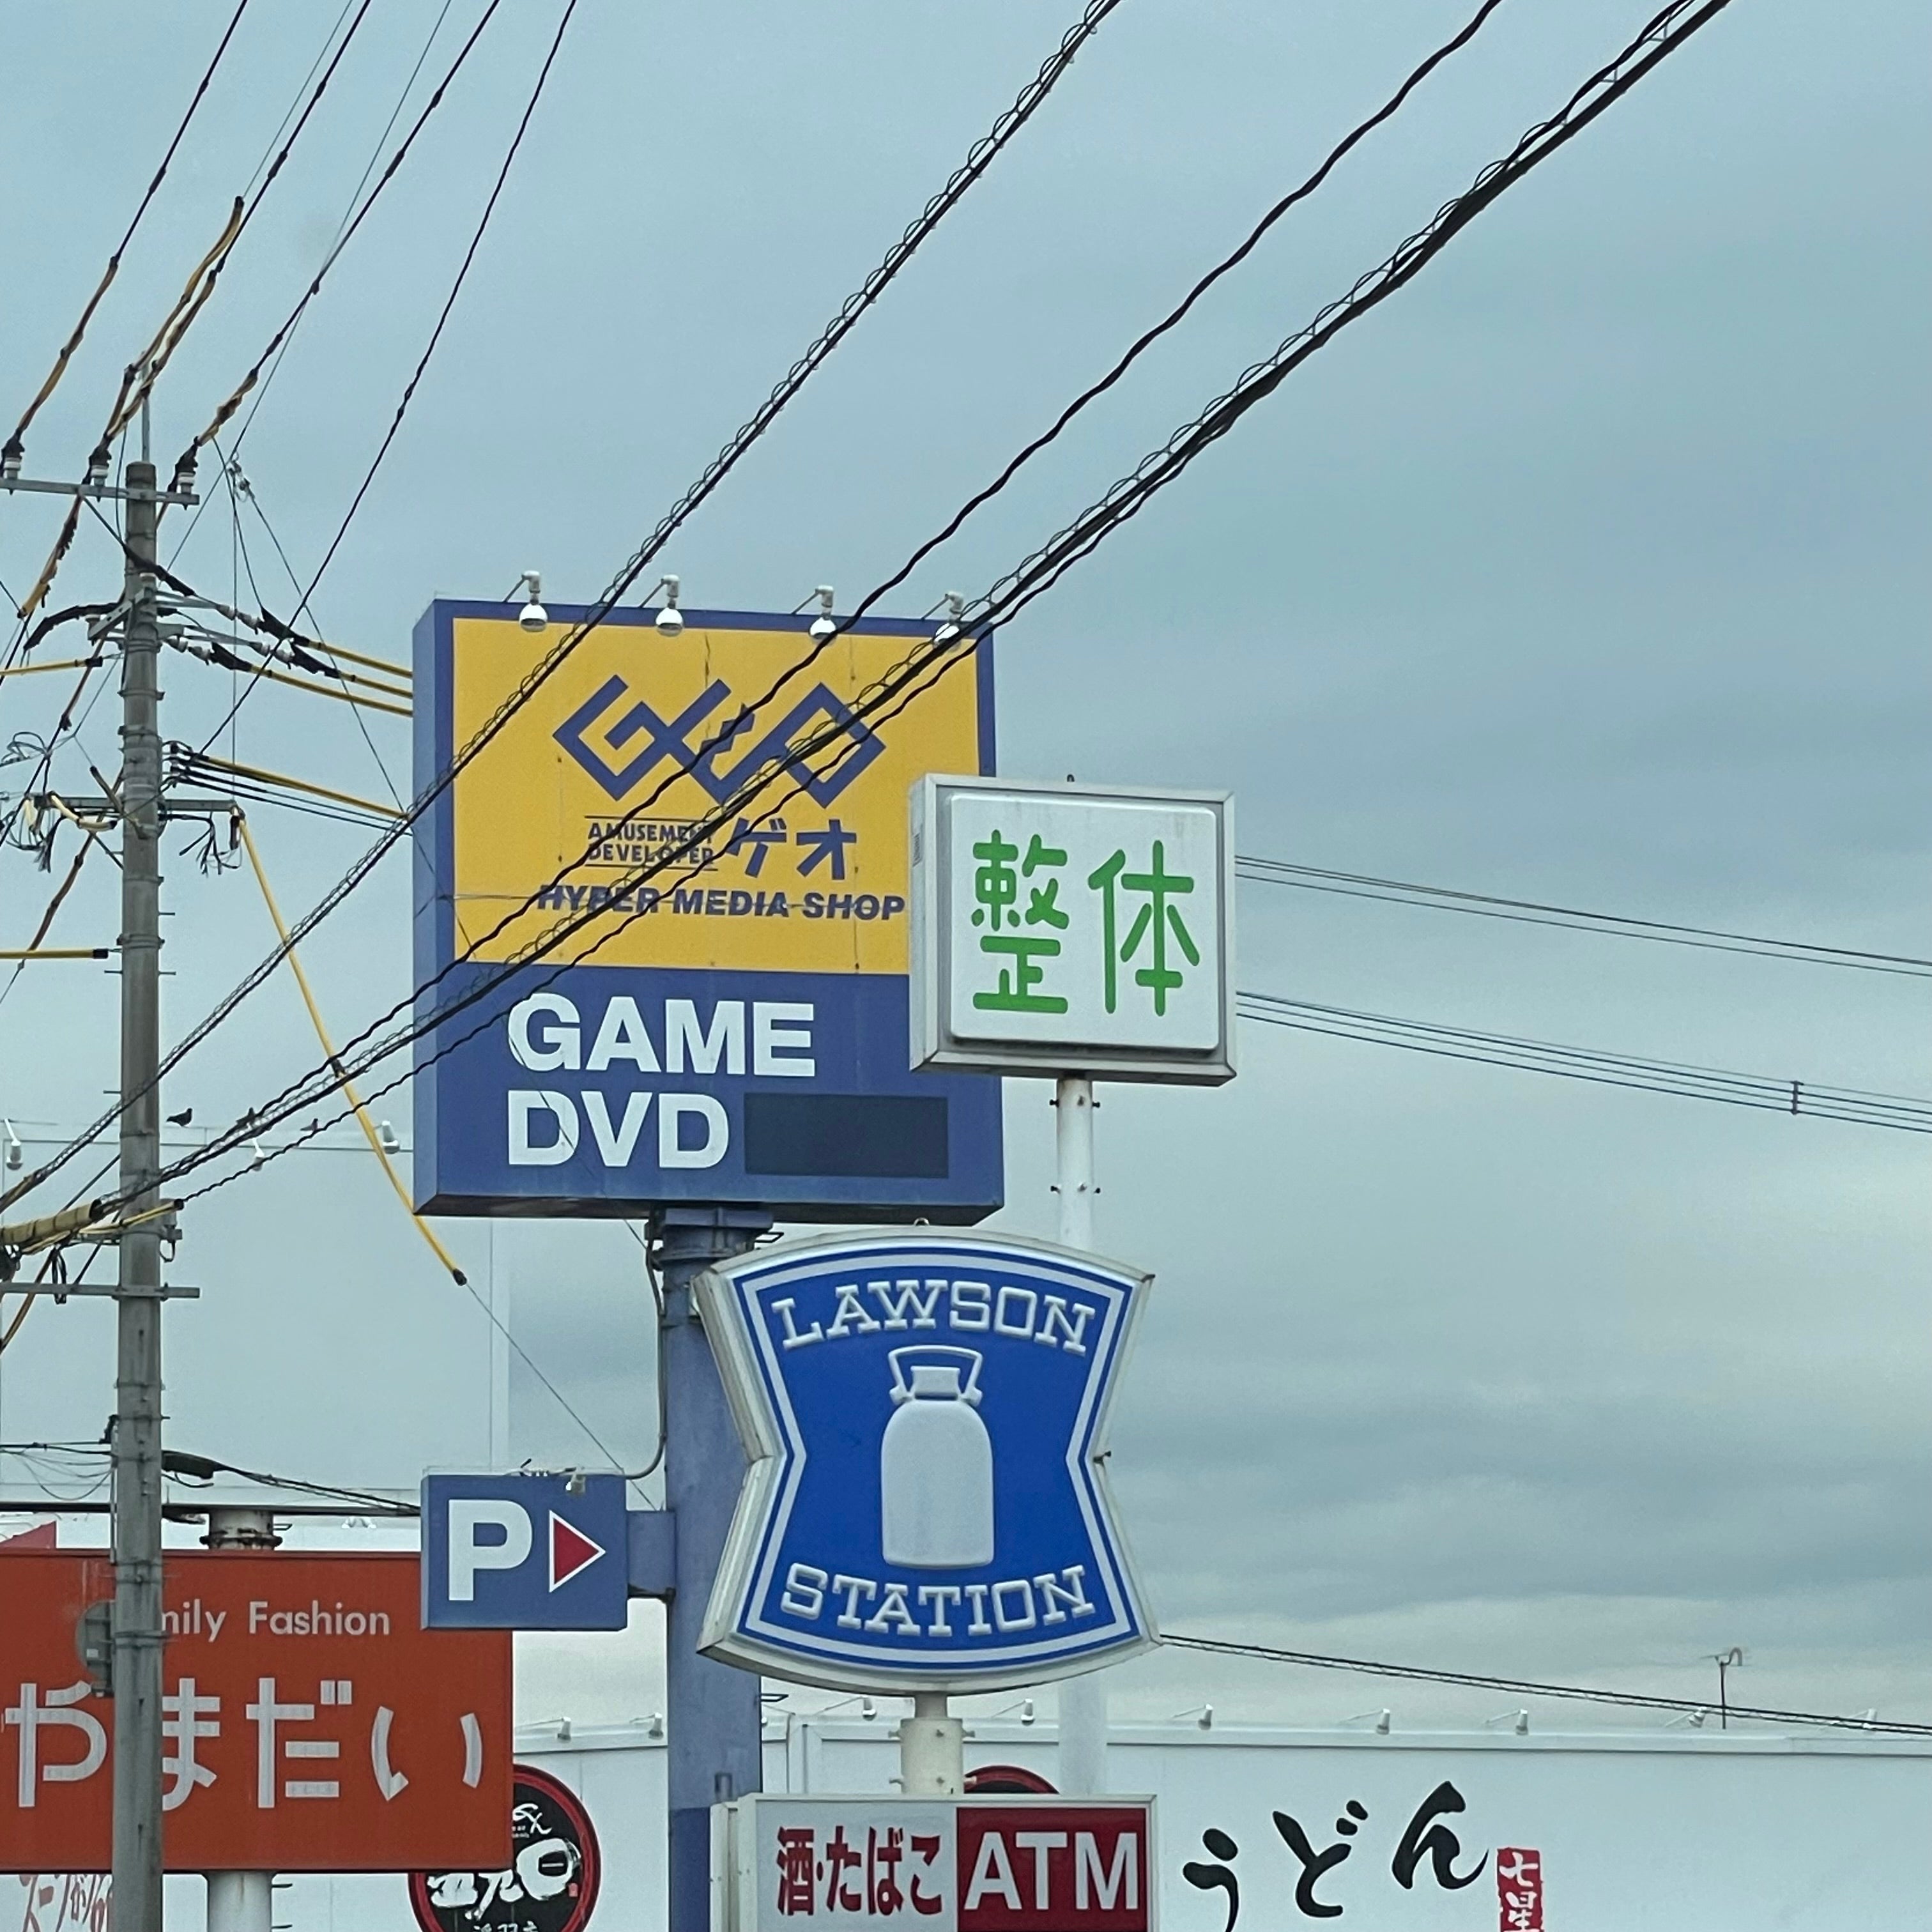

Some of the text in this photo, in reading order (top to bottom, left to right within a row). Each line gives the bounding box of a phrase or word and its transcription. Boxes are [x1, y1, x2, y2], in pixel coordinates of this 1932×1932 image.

[725, 817, 857, 880] ゲオ
[537, 884, 905, 921] HYPER MEDIA SHOP
[970, 829, 1200, 1016] 整体
[508, 992, 816, 1077] GAME
[508, 1089, 730, 1169] DVD
[771, 1278, 1096, 1356] LAWSON
[448, 1499, 533, 1602] P
[249, 1599, 390, 1636] Fashion
[780, 1563, 1096, 1637] STATION
[4, 1677, 484, 1812] やまだい
[963, 1831, 1138, 1911] ATM
[1182, 1781, 1489, 1932] うどん
